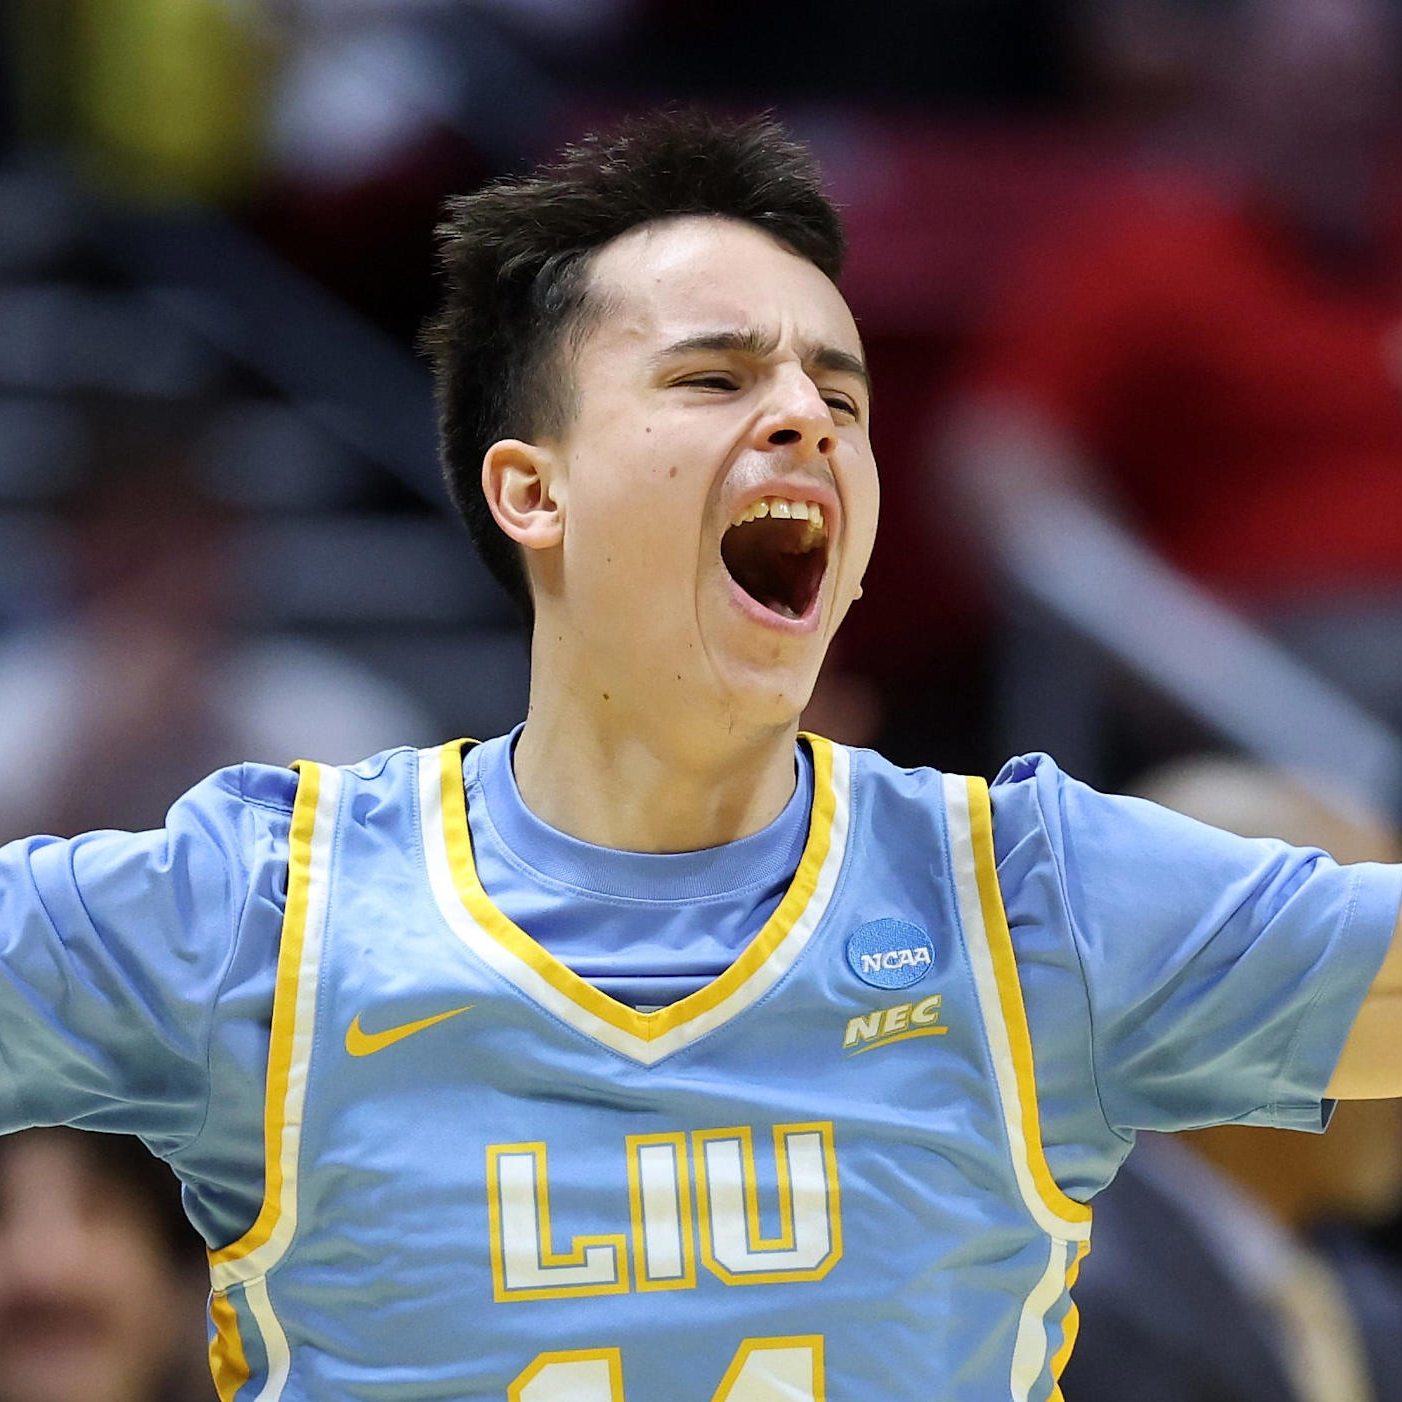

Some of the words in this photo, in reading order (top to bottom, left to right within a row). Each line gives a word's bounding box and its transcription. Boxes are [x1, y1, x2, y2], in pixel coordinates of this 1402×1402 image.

[861, 947, 932, 973] NCAA
[843, 995, 942, 1048] NEC
[486, 1121, 842, 1303] LIU
